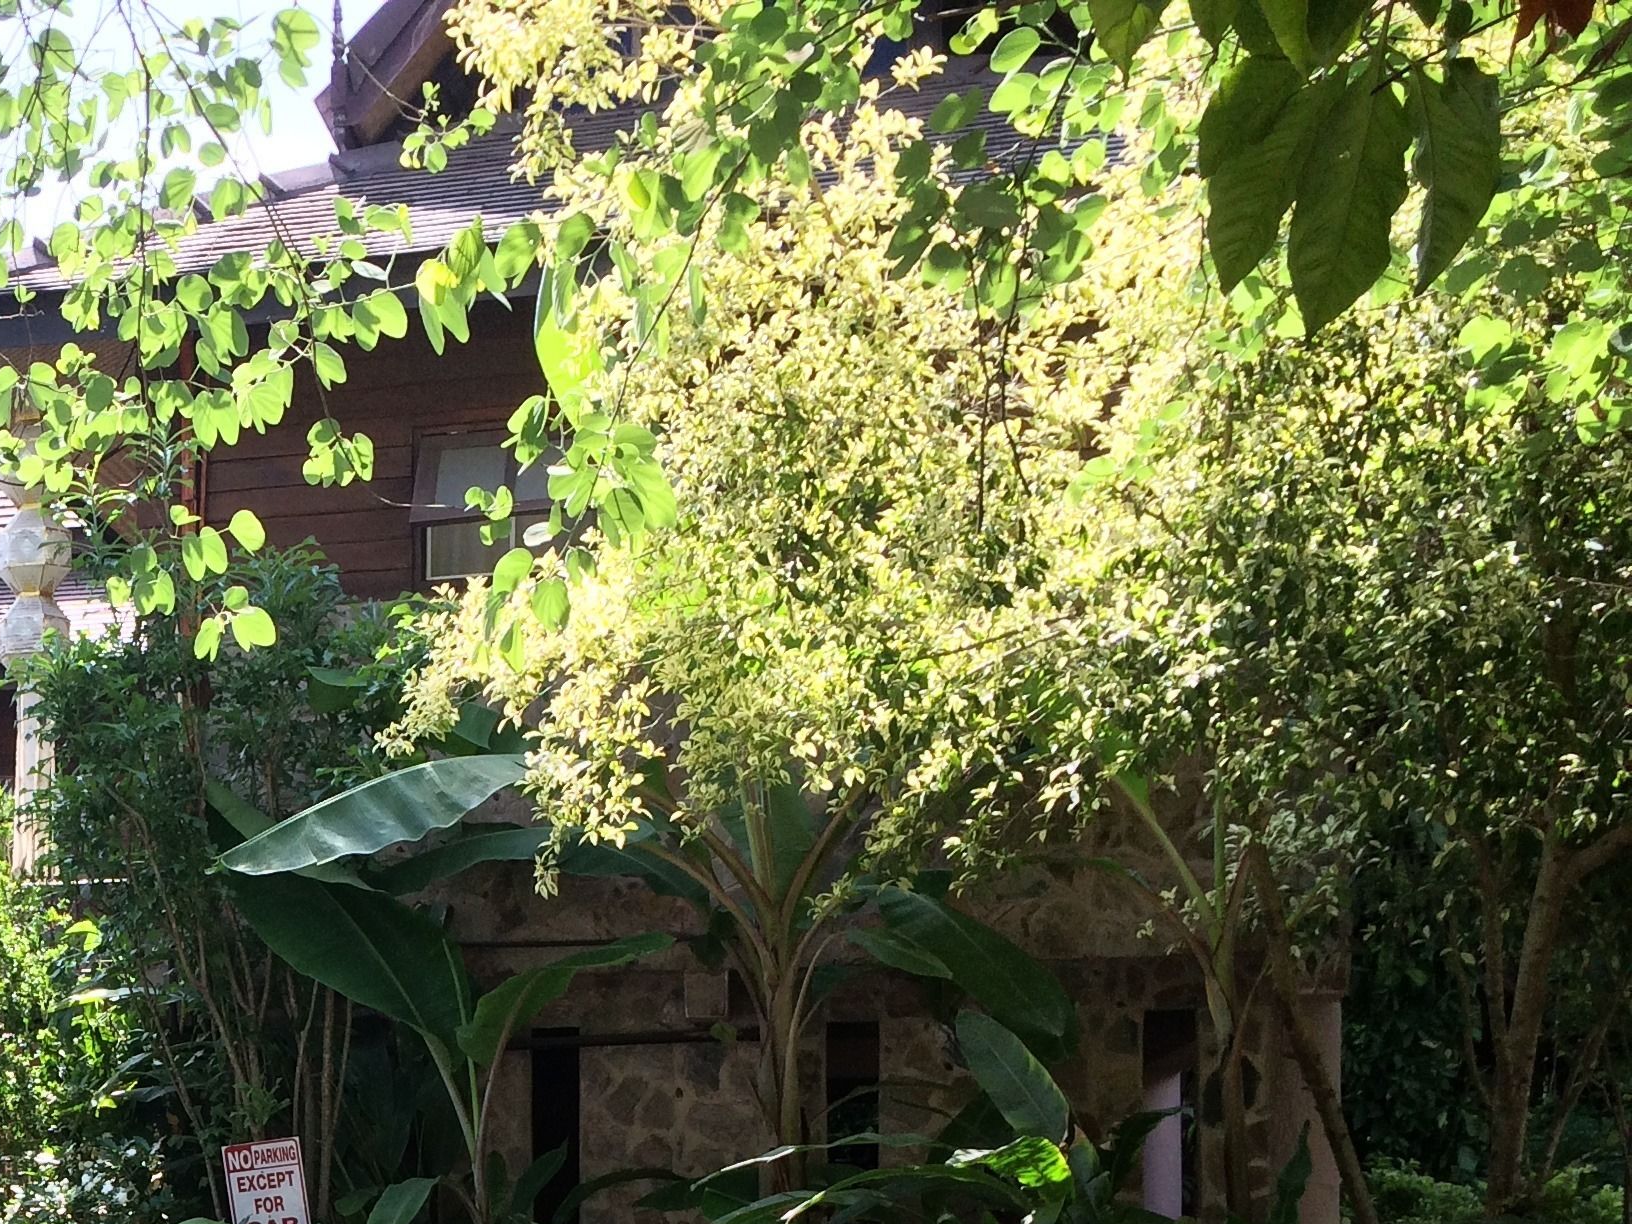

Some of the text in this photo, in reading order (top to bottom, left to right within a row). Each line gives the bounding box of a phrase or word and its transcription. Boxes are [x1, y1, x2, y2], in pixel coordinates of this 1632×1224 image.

[227, 1146, 296, 1171] NO PARKING
[237, 1171, 294, 1193] EXCEPT
[254, 1196, 285, 1214] FOR
